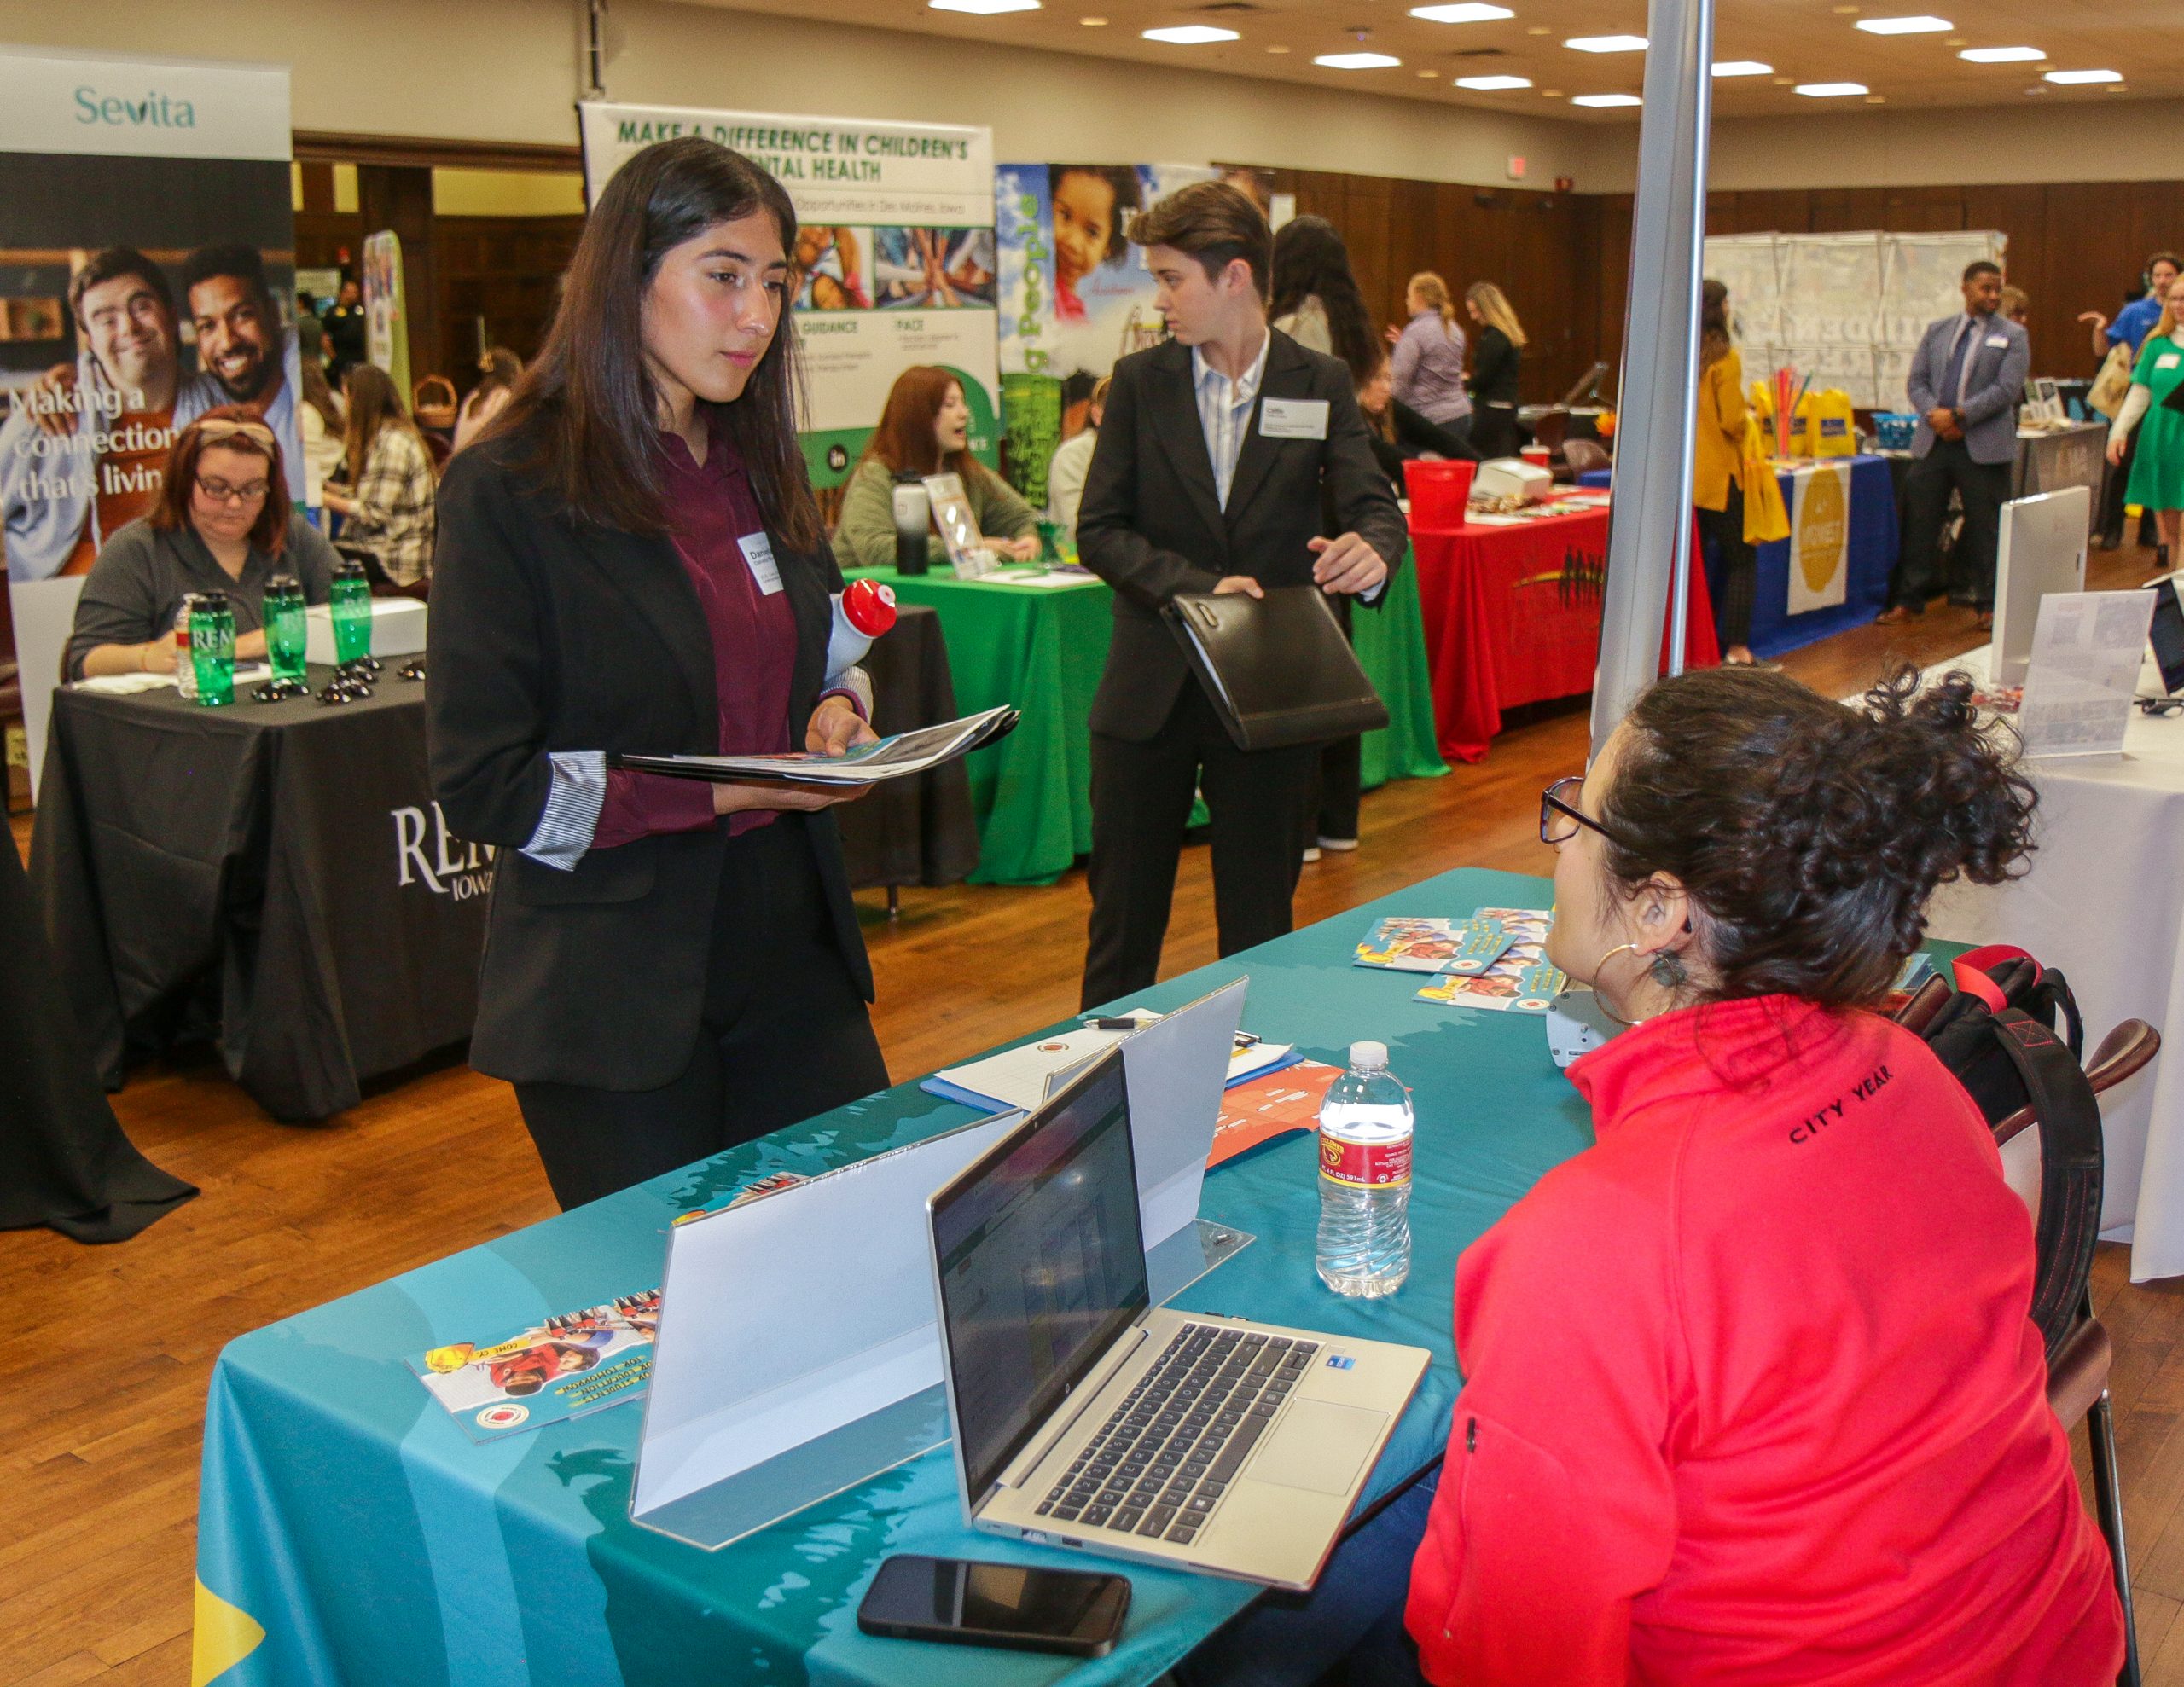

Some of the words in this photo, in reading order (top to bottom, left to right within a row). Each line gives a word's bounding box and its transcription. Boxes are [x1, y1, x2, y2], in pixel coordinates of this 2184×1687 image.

[74, 85, 195, 128] Sevita
[619, 120, 682, 143] MAKE
[713, 125, 834, 153] DIFFERENCE
[838, 133, 859, 154] IN
[865, 134, 969, 160] CHILDREN'S
[751, 154, 804, 178] NTAL
[812, 158, 882, 182] HEALTH
[1016, 194, 1048, 337] People
[802, 320, 858, 334] GUIDANCE
[896, 319, 924, 332] PACE
[9, 383, 124, 420] Making
[129, 388, 146, 409] a
[14, 422, 180, 458] connection
[19, 469, 99, 502] that's
[102, 463, 165, 496] livin
[452, 870, 493, 901] IOW
[1789, 1098, 1844, 1144] CITY
[1852, 1064, 1894, 1102] YEAR
[638, 1371, 652, 1382] OR
[640, 1361, 652, 1371] OR
